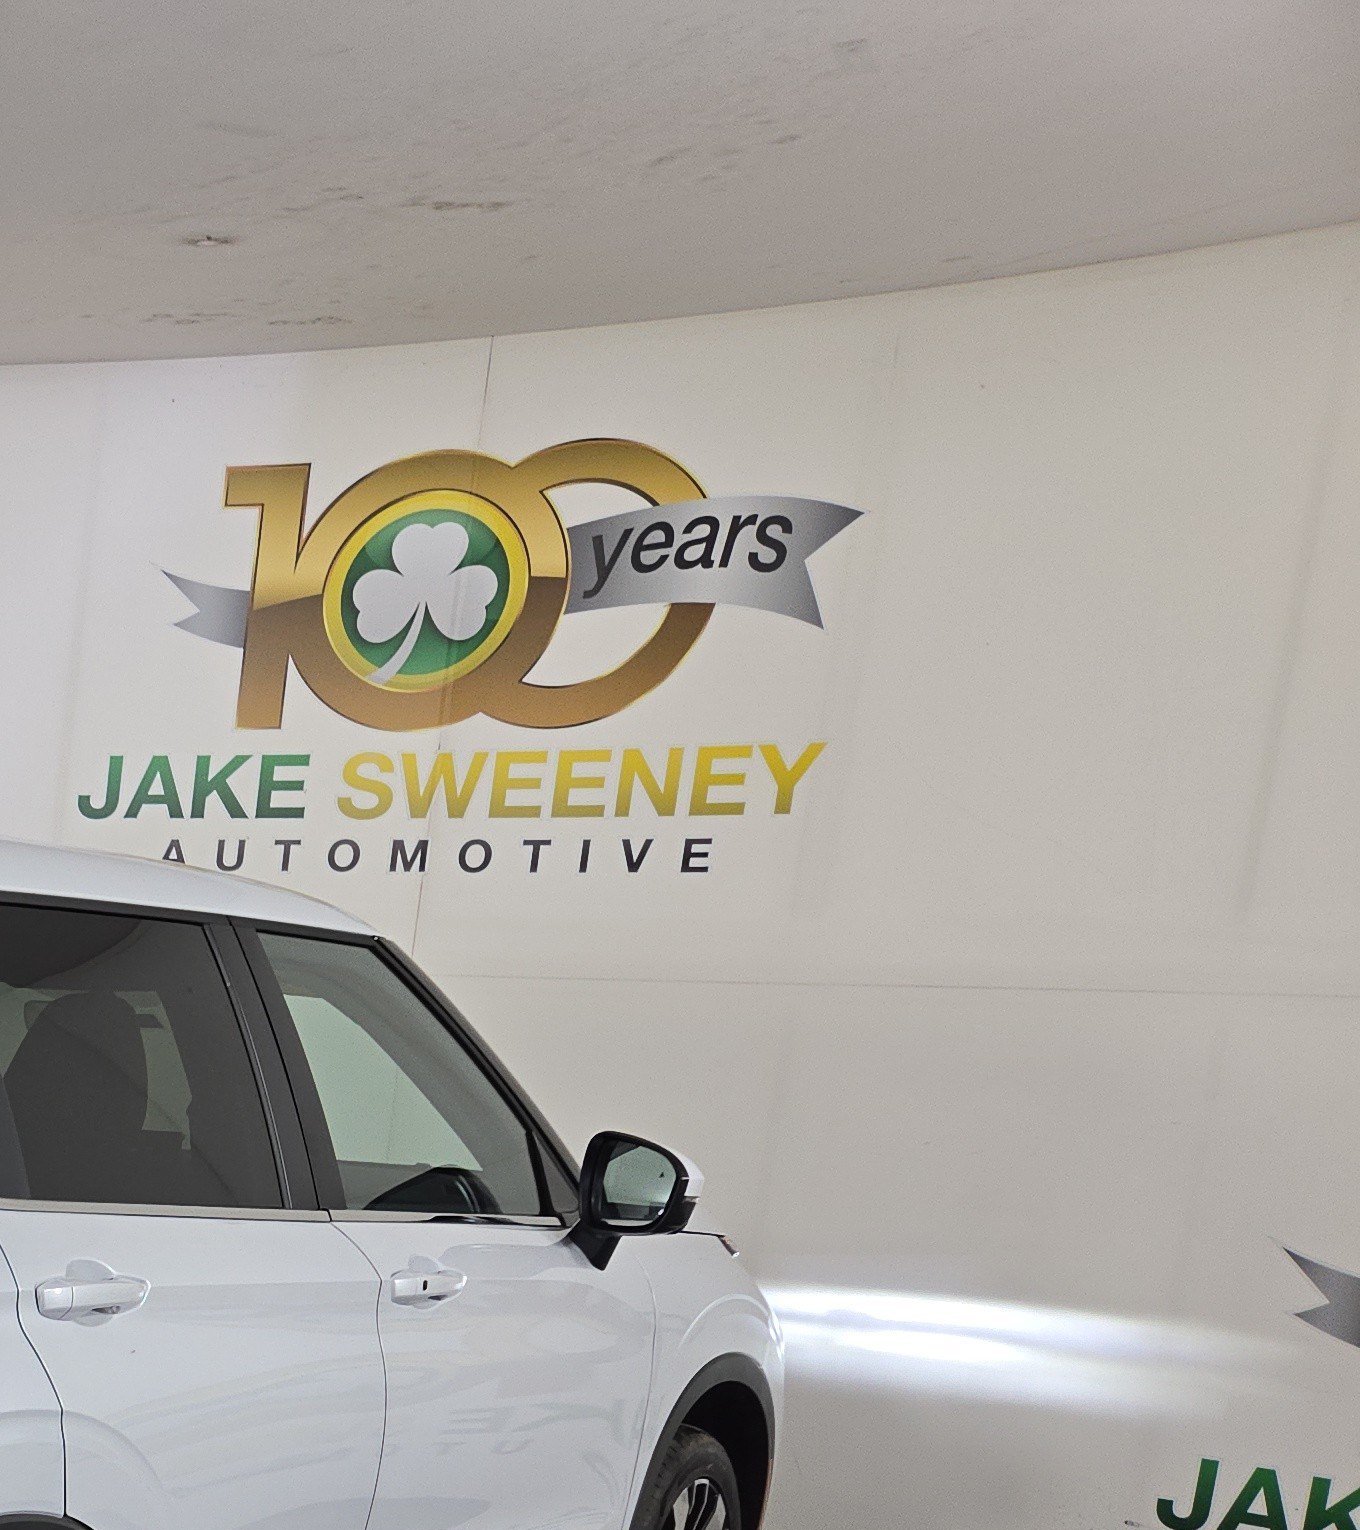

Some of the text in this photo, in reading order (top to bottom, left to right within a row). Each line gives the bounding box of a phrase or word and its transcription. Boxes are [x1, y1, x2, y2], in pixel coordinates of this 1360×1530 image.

[582, 510, 794, 600] years
[77, 741, 828, 822] JAKE SWEENEY
[161, 837, 714, 875] AUTOMOTIVE
